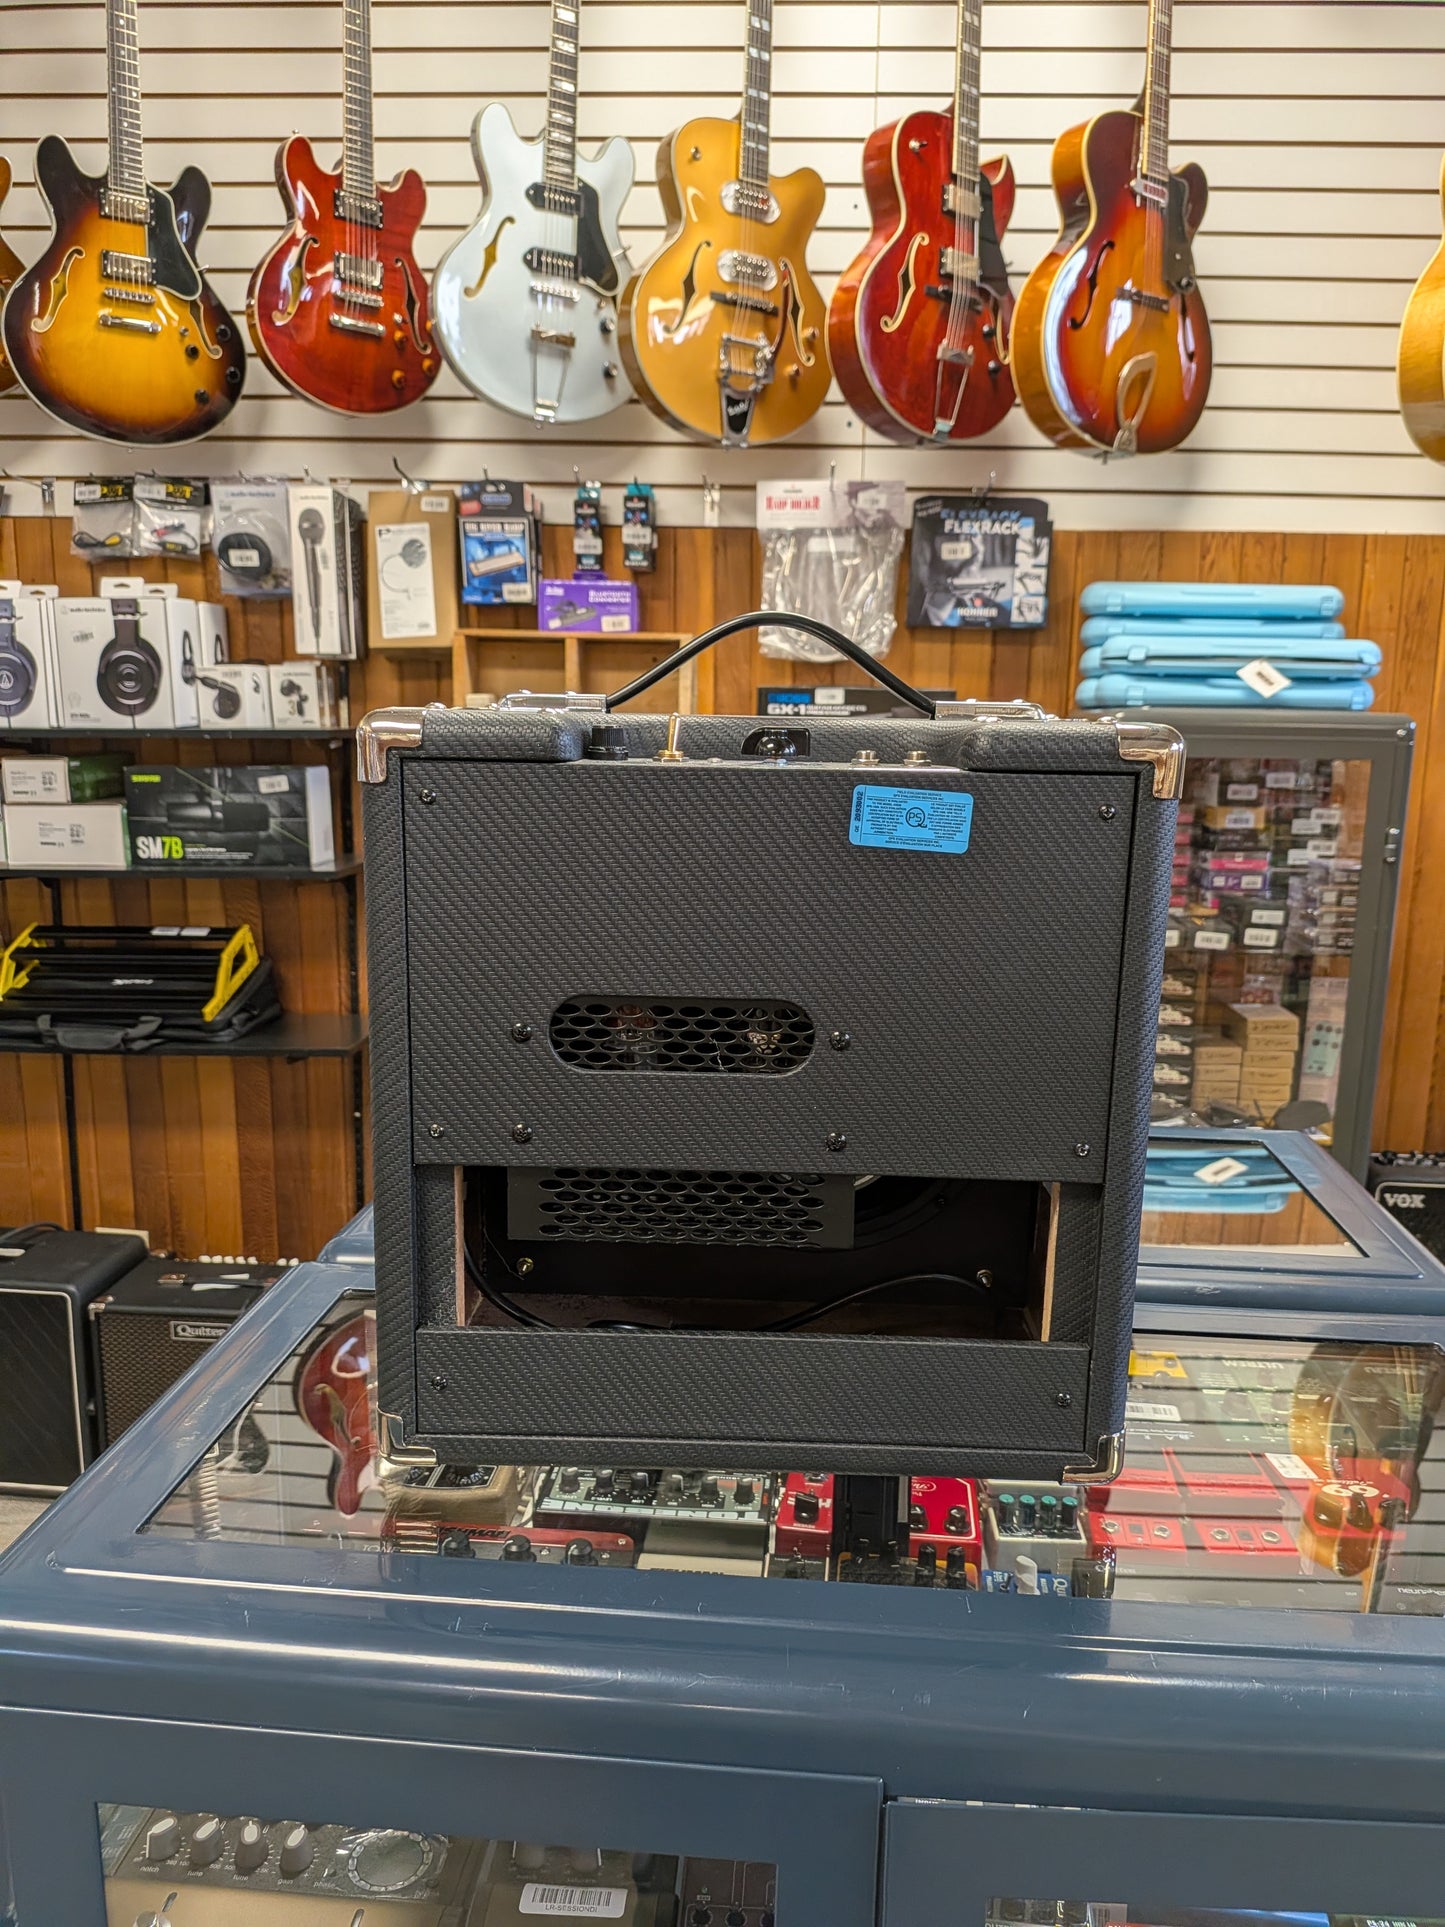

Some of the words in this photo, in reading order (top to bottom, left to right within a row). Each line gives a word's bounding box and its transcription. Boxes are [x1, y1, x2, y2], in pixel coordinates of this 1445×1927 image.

[943, 519, 1021, 535] FLEXRACK
[135, 835, 184, 860] SM7B
[1383, 1192, 1426, 1209] VOX
